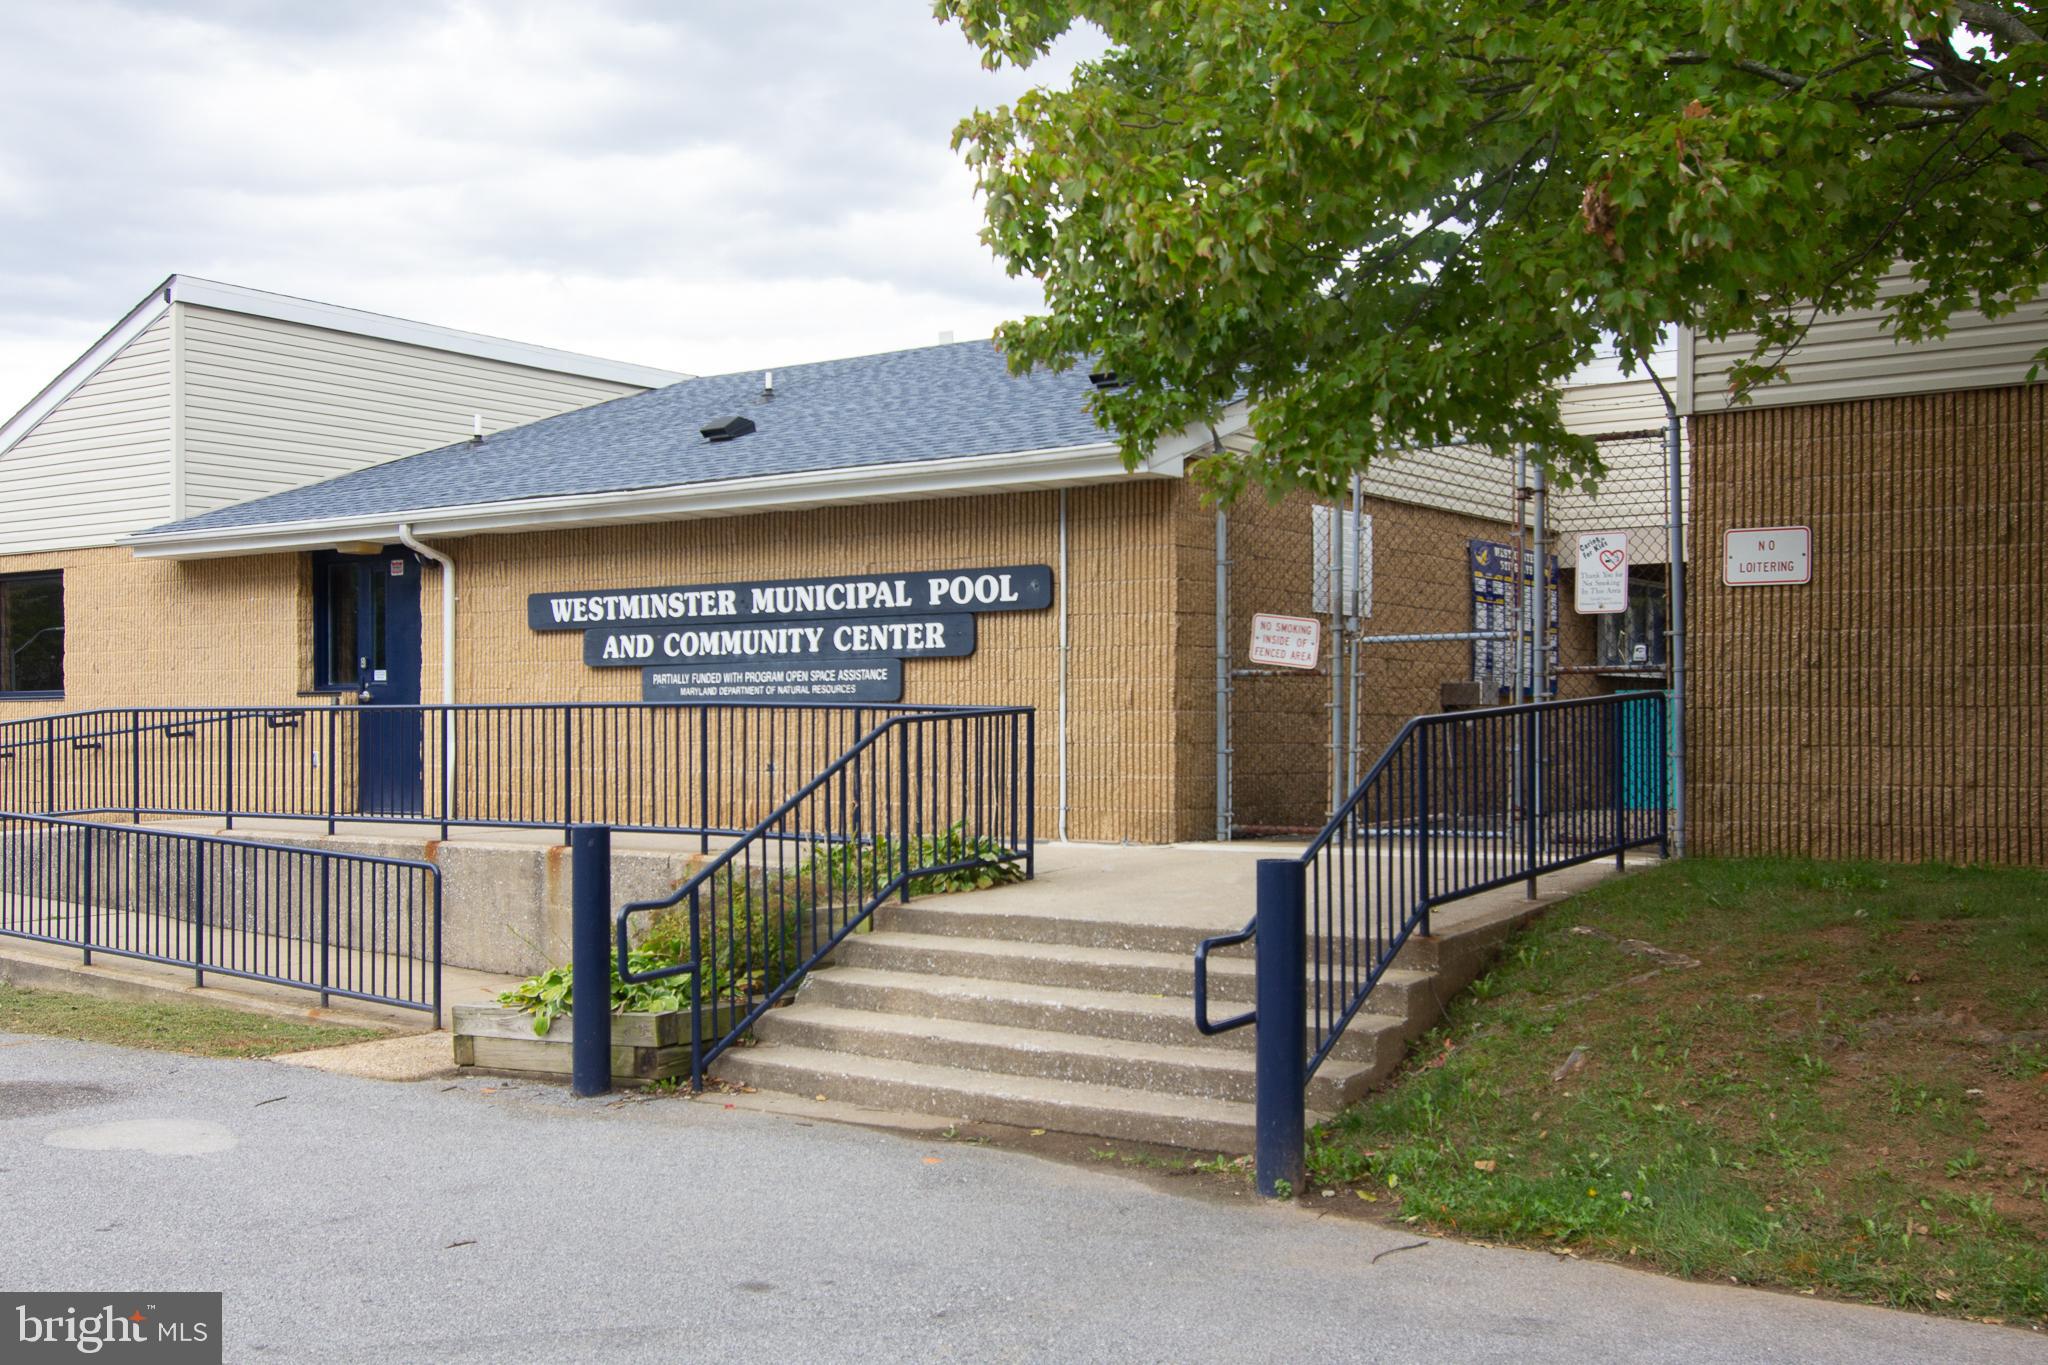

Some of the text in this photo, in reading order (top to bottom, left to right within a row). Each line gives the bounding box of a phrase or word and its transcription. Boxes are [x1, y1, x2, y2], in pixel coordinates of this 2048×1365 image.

[1757, 540, 1775, 551] NO
[1739, 560, 1795, 573] LOITERING
[550, 574, 1019, 623] WESTMINSTER MUNICIPAL POOL
[1260, 621, 1312, 635] NO SMOKING
[602, 622, 946, 659] AND COMMUNITY CENTER
[1262, 634, 1308, 648] INSIDE OF
[1254, 646, 1313, 662] FENCED AREA
[652, 668, 888, 685] PARTIALLY FUNDED WITH PROGRAM OPEN SPACE ASSISTANCE
[680, 684, 856, 696] MARYLAND DEPARTMENT OF NATURAL RESOURCES
